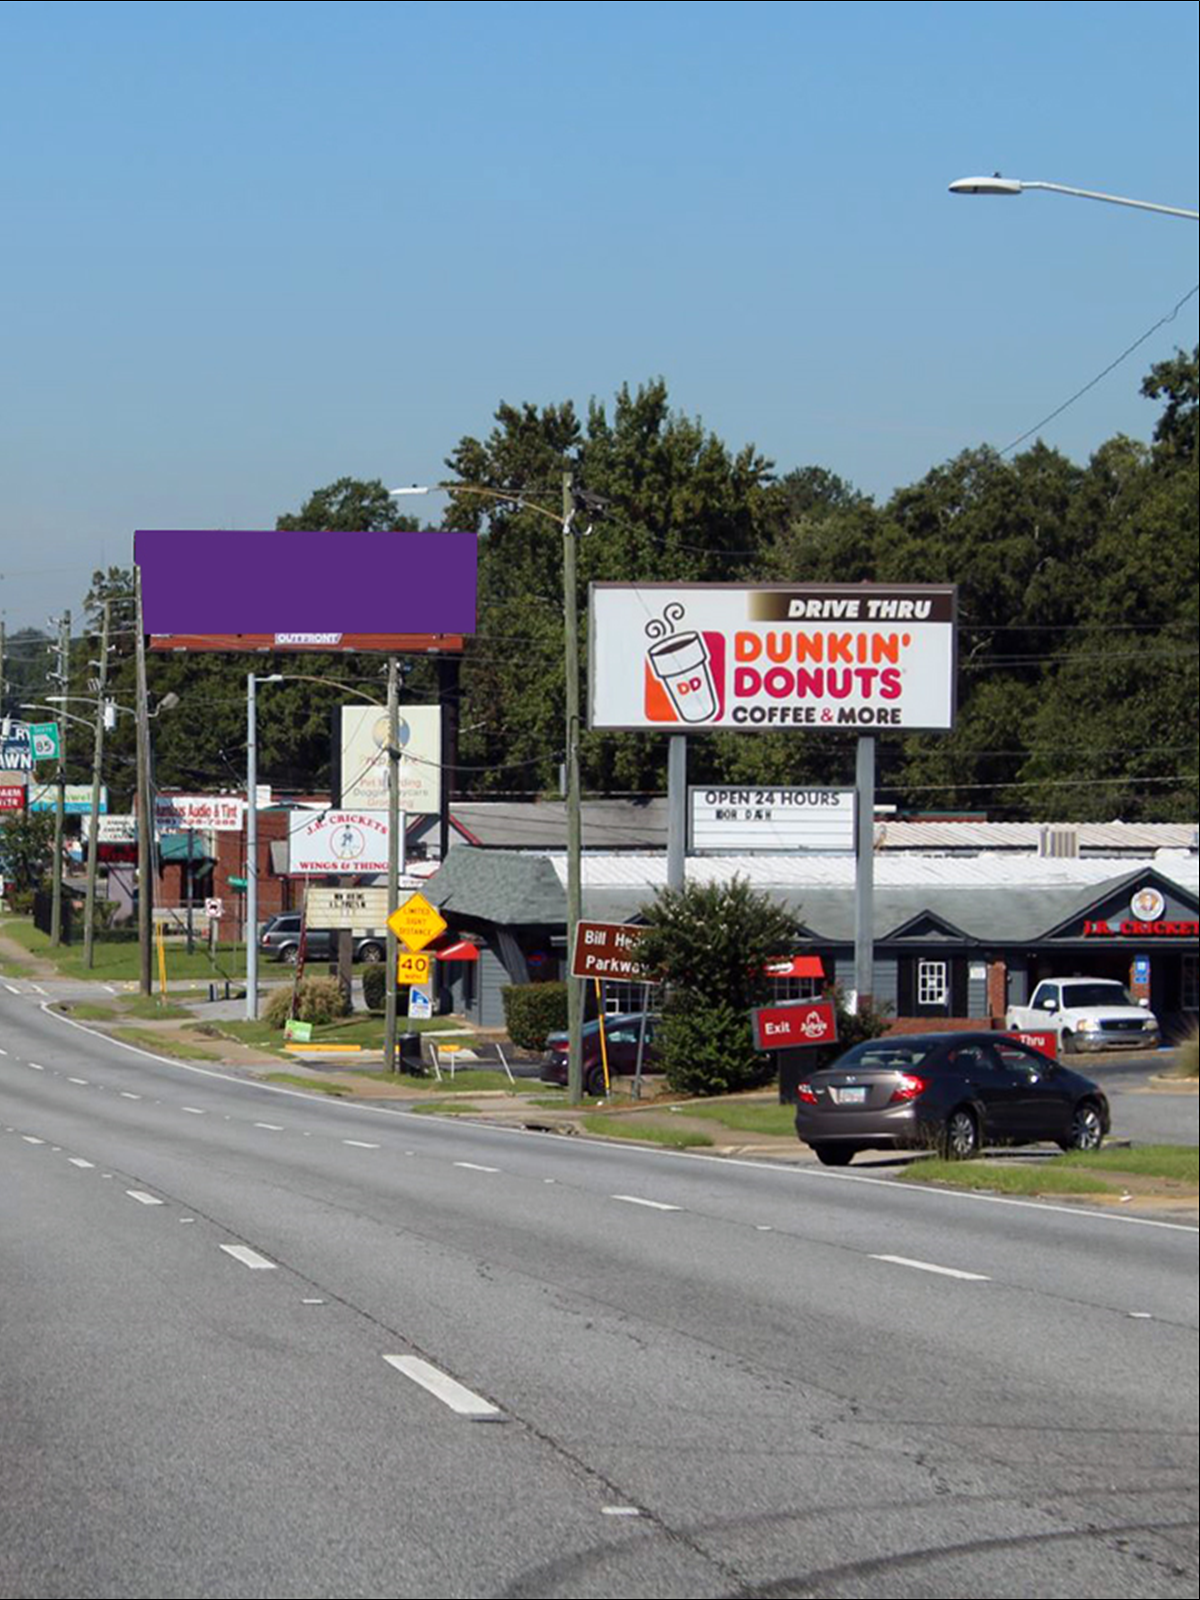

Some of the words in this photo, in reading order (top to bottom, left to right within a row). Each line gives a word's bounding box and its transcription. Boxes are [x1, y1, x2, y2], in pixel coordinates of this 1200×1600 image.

[788, 600, 859, 619] DRIVE
[866, 600, 932, 619] THRU
[277, 633, 339, 644] OUTFRONT
[734, 631, 911, 664] DUNKIN'
[677, 677, 702, 696] DD
[734, 667, 902, 700] DONUTS
[732, 706, 816, 724] COFFEE
[820, 707, 834, 723] &
[837, 707, 902, 725] MORE
[705, 791, 750, 805] OPEN
[755, 791, 775, 805] 24
[781, 791, 840, 806] HOURS
[329, 814, 389, 835] CRICKETS
[299, 861, 339, 870] WINGS
[341, 861, 351, 870] &
[353, 861, 390, 870] THING
[1084, 921, 1114, 935] J.R.
[585, 930, 607, 946] Bill
[401, 958, 427, 972] 40
[765, 1021, 790, 1035] Exit
[1019, 1034, 1045, 1047] Thru
